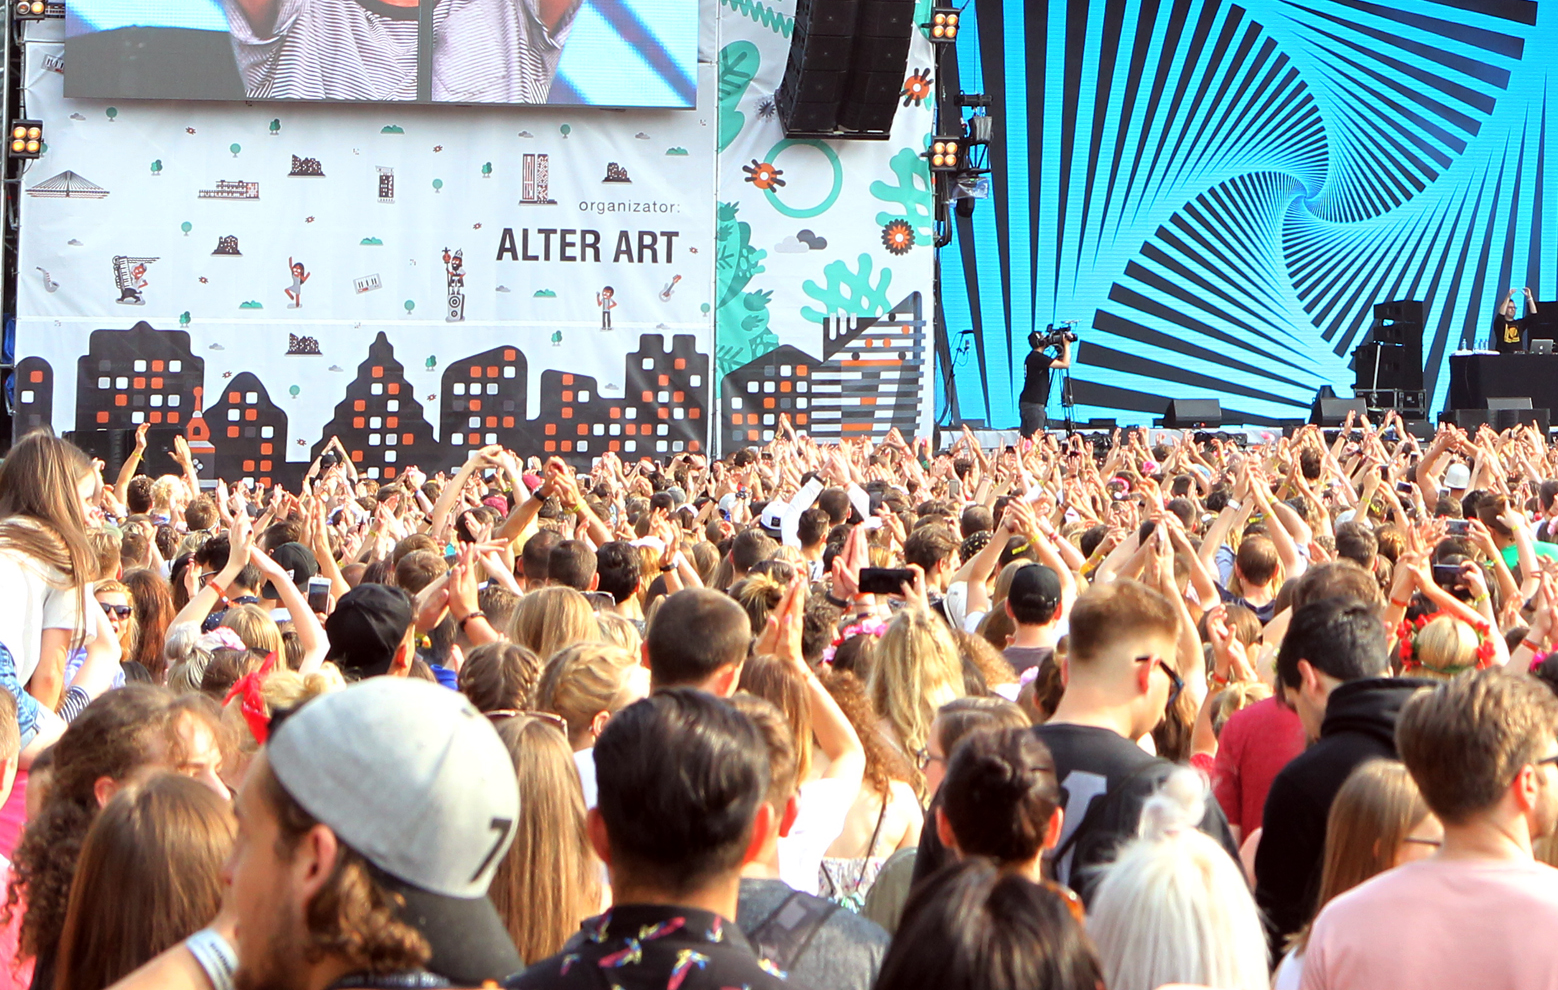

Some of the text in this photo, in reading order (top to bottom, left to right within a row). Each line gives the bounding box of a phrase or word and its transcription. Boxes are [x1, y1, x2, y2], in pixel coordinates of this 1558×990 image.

[578, 199, 681, 215] organizator:
[496, 227, 680, 264] ALTER ART
[467, 816, 513, 885] 7
